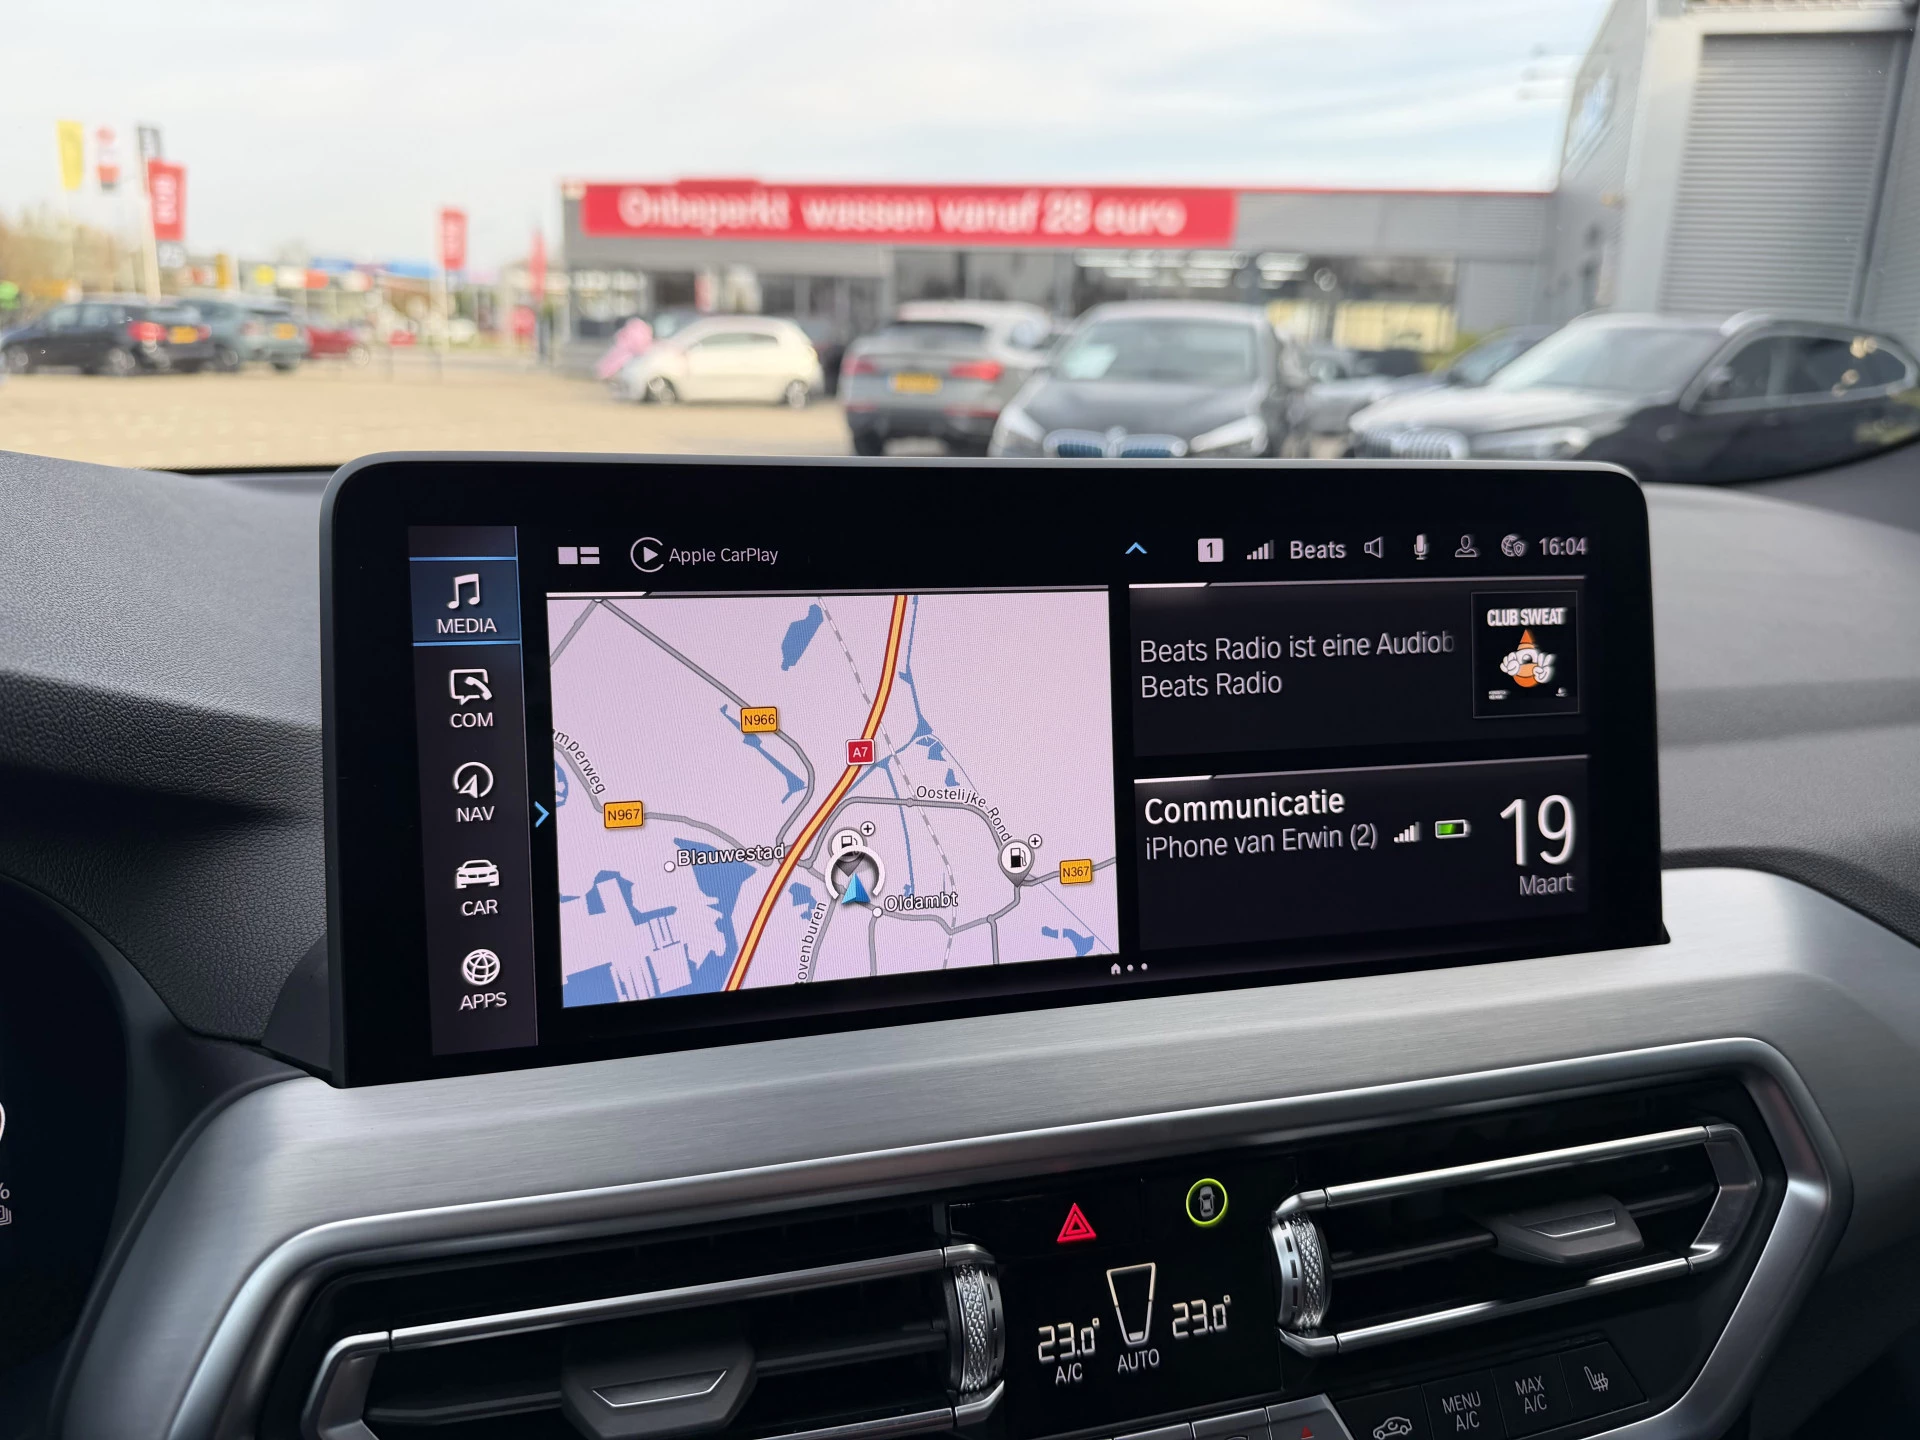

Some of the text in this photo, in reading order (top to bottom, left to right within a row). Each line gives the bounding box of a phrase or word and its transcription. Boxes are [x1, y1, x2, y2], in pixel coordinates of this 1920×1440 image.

[619, 186, 1186, 235] Onbeperkt wassen vanaf 28 euro
[668, 547, 779, 565] Apple CarPlay
[1206, 542, 1213, 559] 1
[1290, 541, 1346, 559] Beats
[1538, 537, 1587, 556] 16:04
[437, 617, 497, 633] MEDIA
[1486, 607, 1567, 626] CLUB SWEAT
[1140, 630, 1454, 663] Beats Radio ist eine Audiob
[1141, 671, 1283, 698] Beats Radio
[450, 712, 494, 728] COM
[744, 714, 776, 726] N966
[553, 729, 606, 795] mperweg
[852, 746, 869, 758] A7
[456, 806, 495, 822] NAV
[607, 808, 640, 821] N967
[916, 785, 1013, 842] Oostelijke Rond
[1144, 789, 1345, 824] Communicatie
[1500, 794, 1576, 866] 19
[1146, 823, 1378, 860] iPhone van Erwin (2)
[676, 843, 786, 867] Blauwestad
[1062, 866, 1090, 878] N367
[1519, 873, 1575, 896] Maart
[461, 900, 499, 916] CAR
[884, 892, 959, 912] Oldambt
[797, 902, 827, 984] ovenburen
[459, 992, 508, 1011] APPS
[1117, 1349, 1160, 1373] AUTO
[1055, 1363, 1083, 1385] A/C
[1515, 1376, 1545, 1396] MAX
[1441, 1391, 1481, 1414] MENU
[1524, 1393, 1548, 1414] A/C
[1456, 1410, 1480, 1432] A/C
